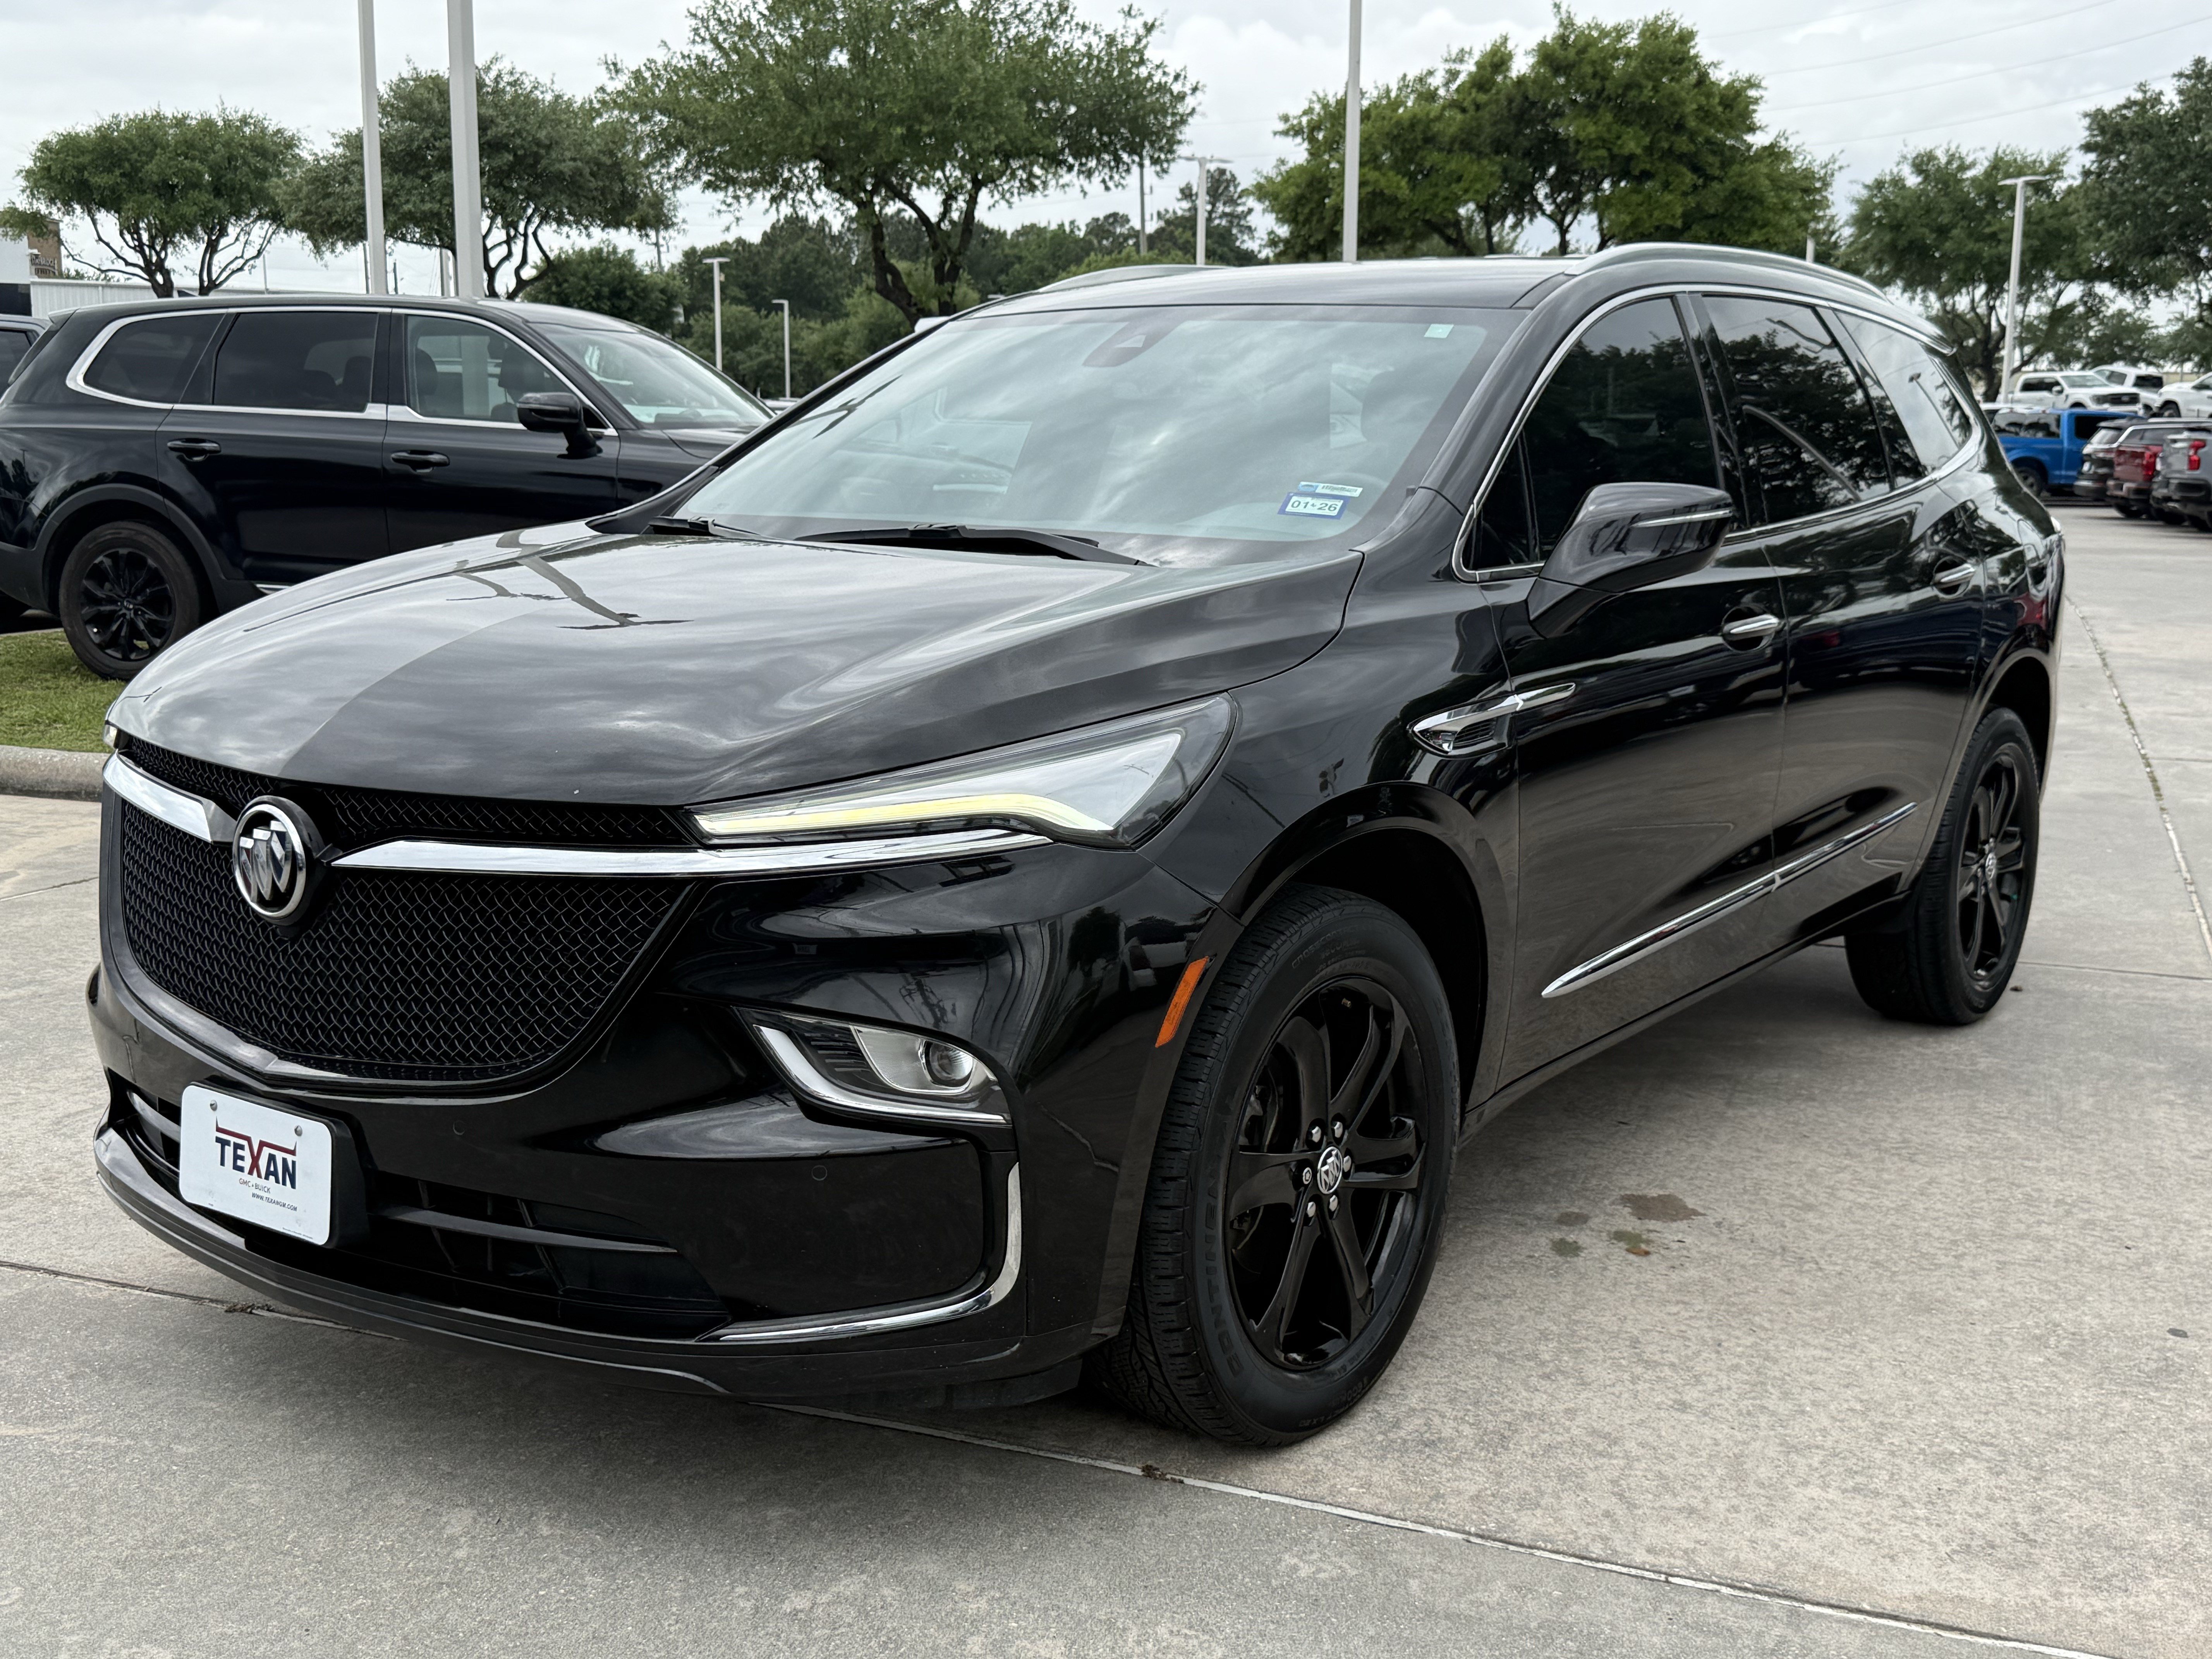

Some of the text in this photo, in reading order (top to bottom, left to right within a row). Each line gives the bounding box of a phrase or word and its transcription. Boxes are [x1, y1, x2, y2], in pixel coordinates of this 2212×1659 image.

[1291, 500, 1310, 509] 01
[1317, 503, 1339, 512] 26
[215, 1135, 297, 1190] TEXAN
[239, 1178, 271, 1194] GMC BUICK
